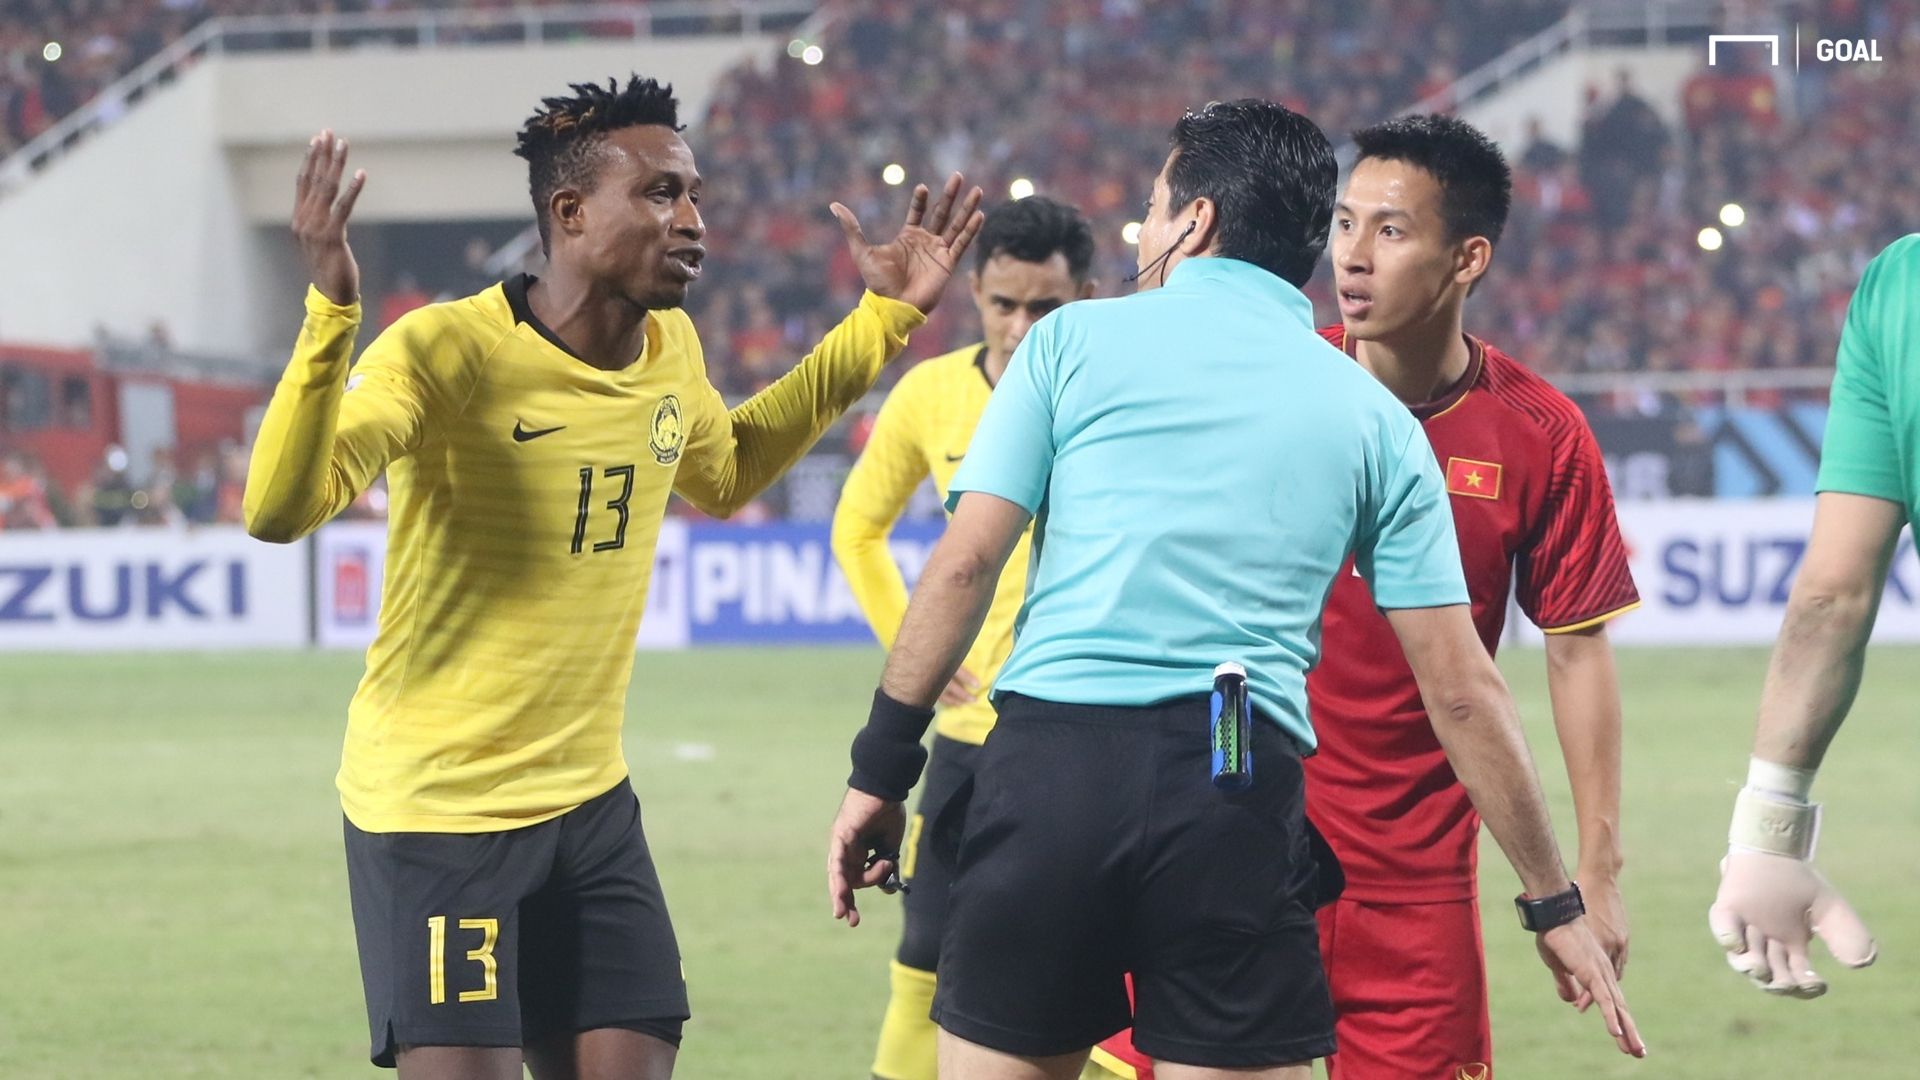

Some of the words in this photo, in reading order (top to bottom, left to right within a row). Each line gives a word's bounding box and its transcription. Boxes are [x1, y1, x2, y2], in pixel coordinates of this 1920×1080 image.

[570, 464, 636, 554] 13
[692, 540, 936, 624] PINA
[1661, 538, 1913, 607] SUZ
[428, 915, 499, 1005] 13
